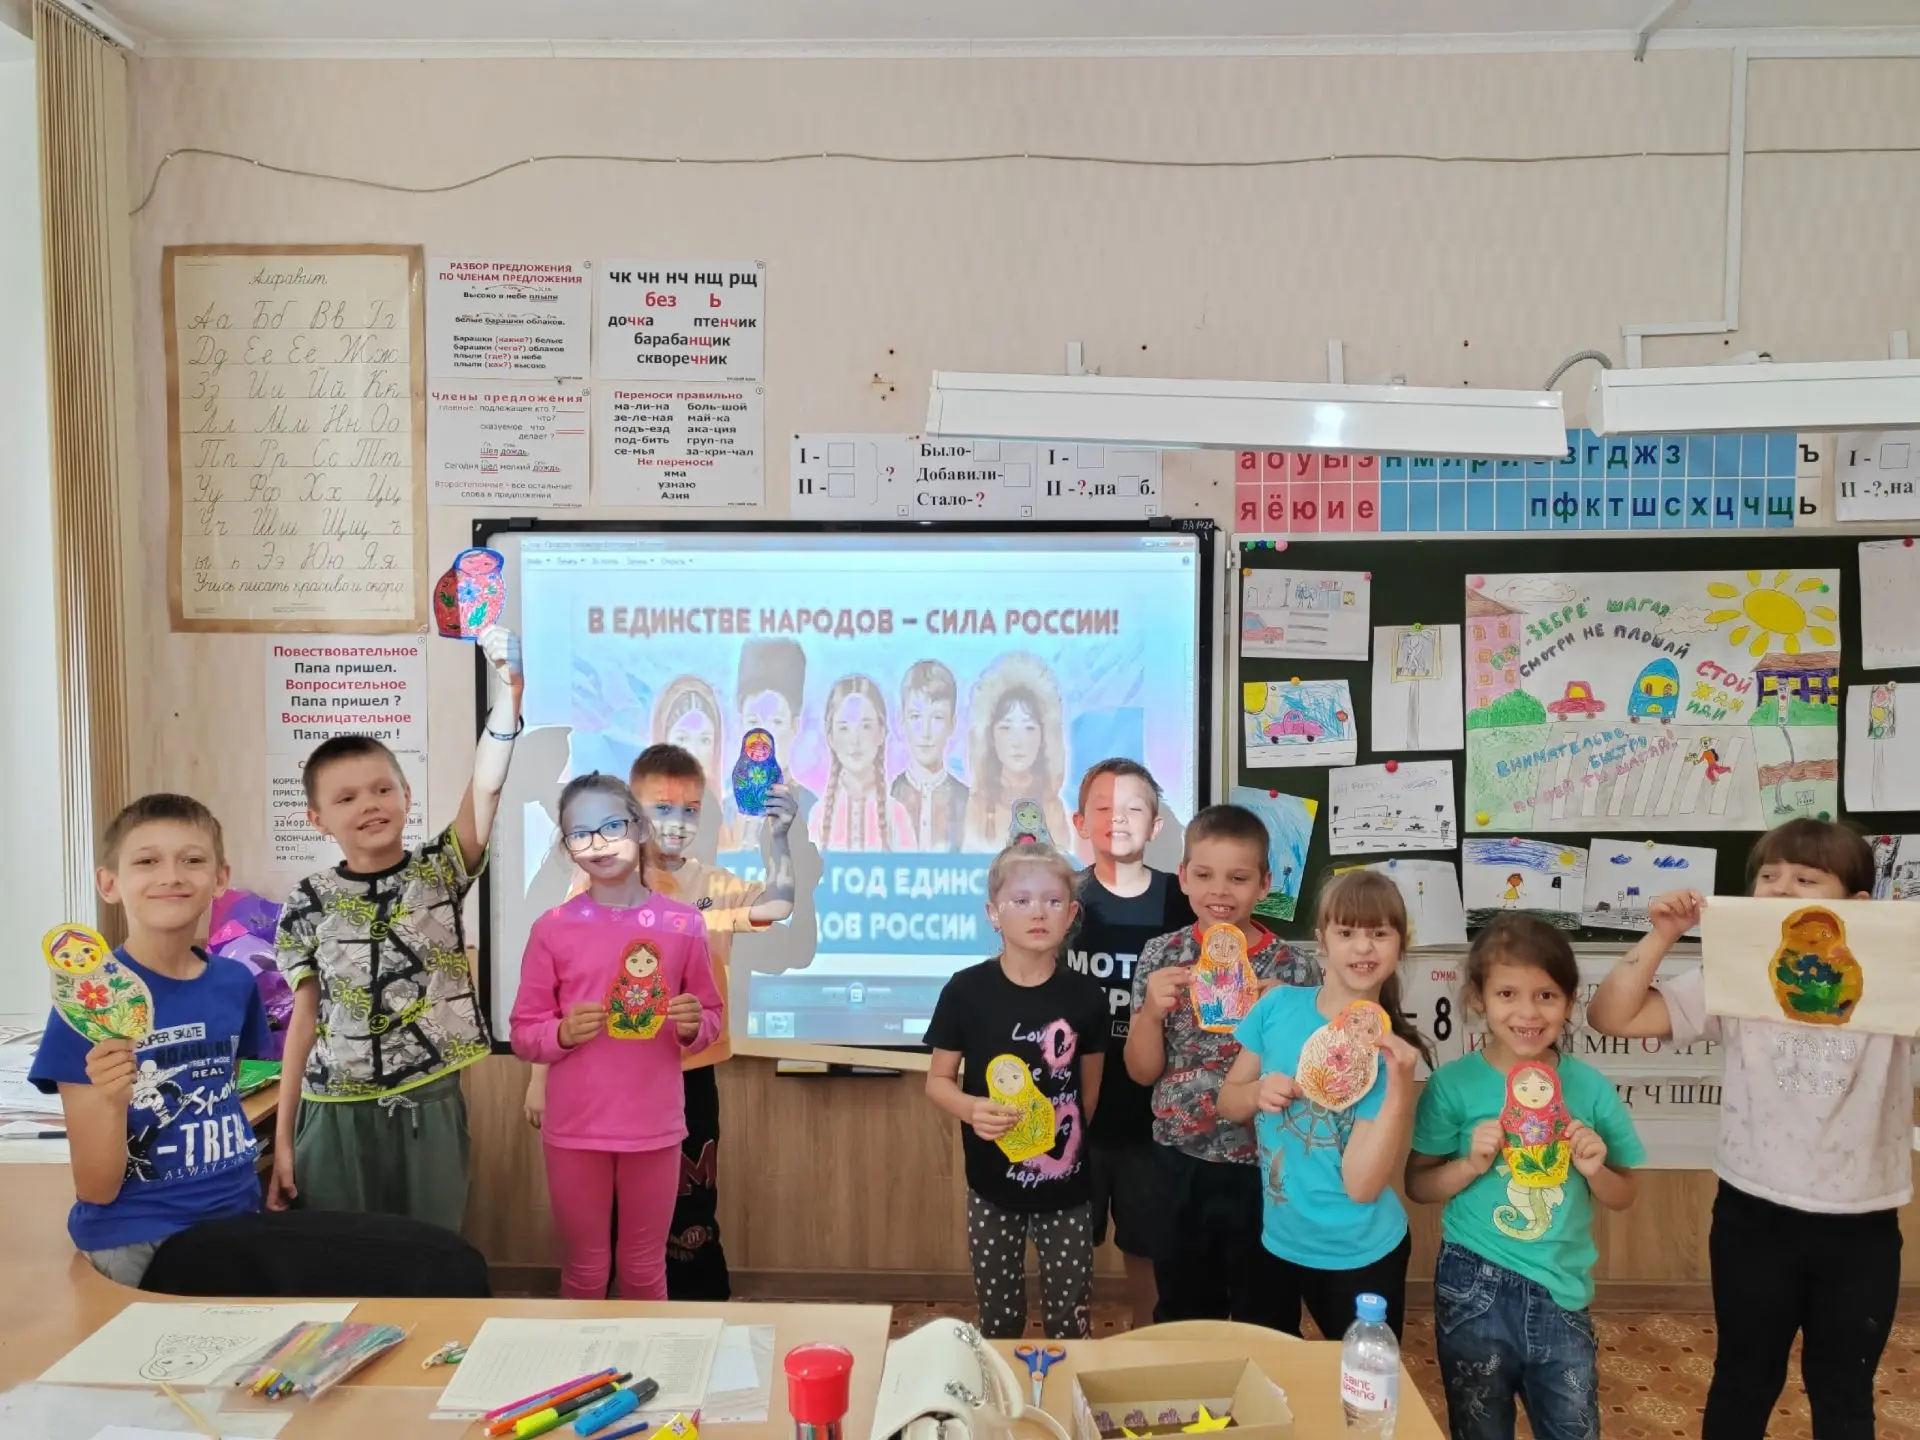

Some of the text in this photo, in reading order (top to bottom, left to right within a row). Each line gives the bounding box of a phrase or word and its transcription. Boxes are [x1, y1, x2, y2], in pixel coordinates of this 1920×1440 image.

[450, 262, 572, 273] РАЗБОР ПРЕДЛОЖЕНИЯ
[439, 273, 582, 283] ПО ЧЛЕНАМ ПРЕДЛОЖЕНИЯ
[609, 271, 757, 288] чк чн нч нщ рщ
[645, 291, 676, 307] без
[608, 316, 756, 328] дочка птенчик
[634, 332, 731, 347] барабанщик
[637, 354, 727, 366] скворечник
[432, 392, 583, 403] Члены предложения
[614, 391, 743, 400] Переноси правильно
[687, 403, 747, 411] боль-шой
[687, 414, 730, 422] май-ка
[614, 426, 670, 434] подъ-езд
[614, 436, 734, 446] под-бить груп-па
[686, 449, 754, 457] за-кри-чал
[638, 458, 714, 467] Не переноси
[587, 607, 1119, 639] В ЕДИНСТВЕ НАРОДОВ СИЛА РОССИИ!
[274, 646, 418, 657] Повествовательное
[1520, 633, 1576, 678] СМОТРИ
[1583, 623, 1605, 640] НЕ
[295, 662, 396, 675] Папа пришел.
[1696, 660, 1753, 694] СТОЙ
[286, 680, 406, 692] Вопросительное
[291, 696, 327, 707] Папа
[332, 697, 389, 708] пришел
[281, 713, 411, 724] Восклицательное
[293, 729, 329, 740] Папа
[832, 867, 990, 899] ГОД ЕДИНС
[870, 914, 977, 941] РОССИИ
[174, 1026, 203, 1040] SKATE
[192, 1068, 224, 1078] REAL
